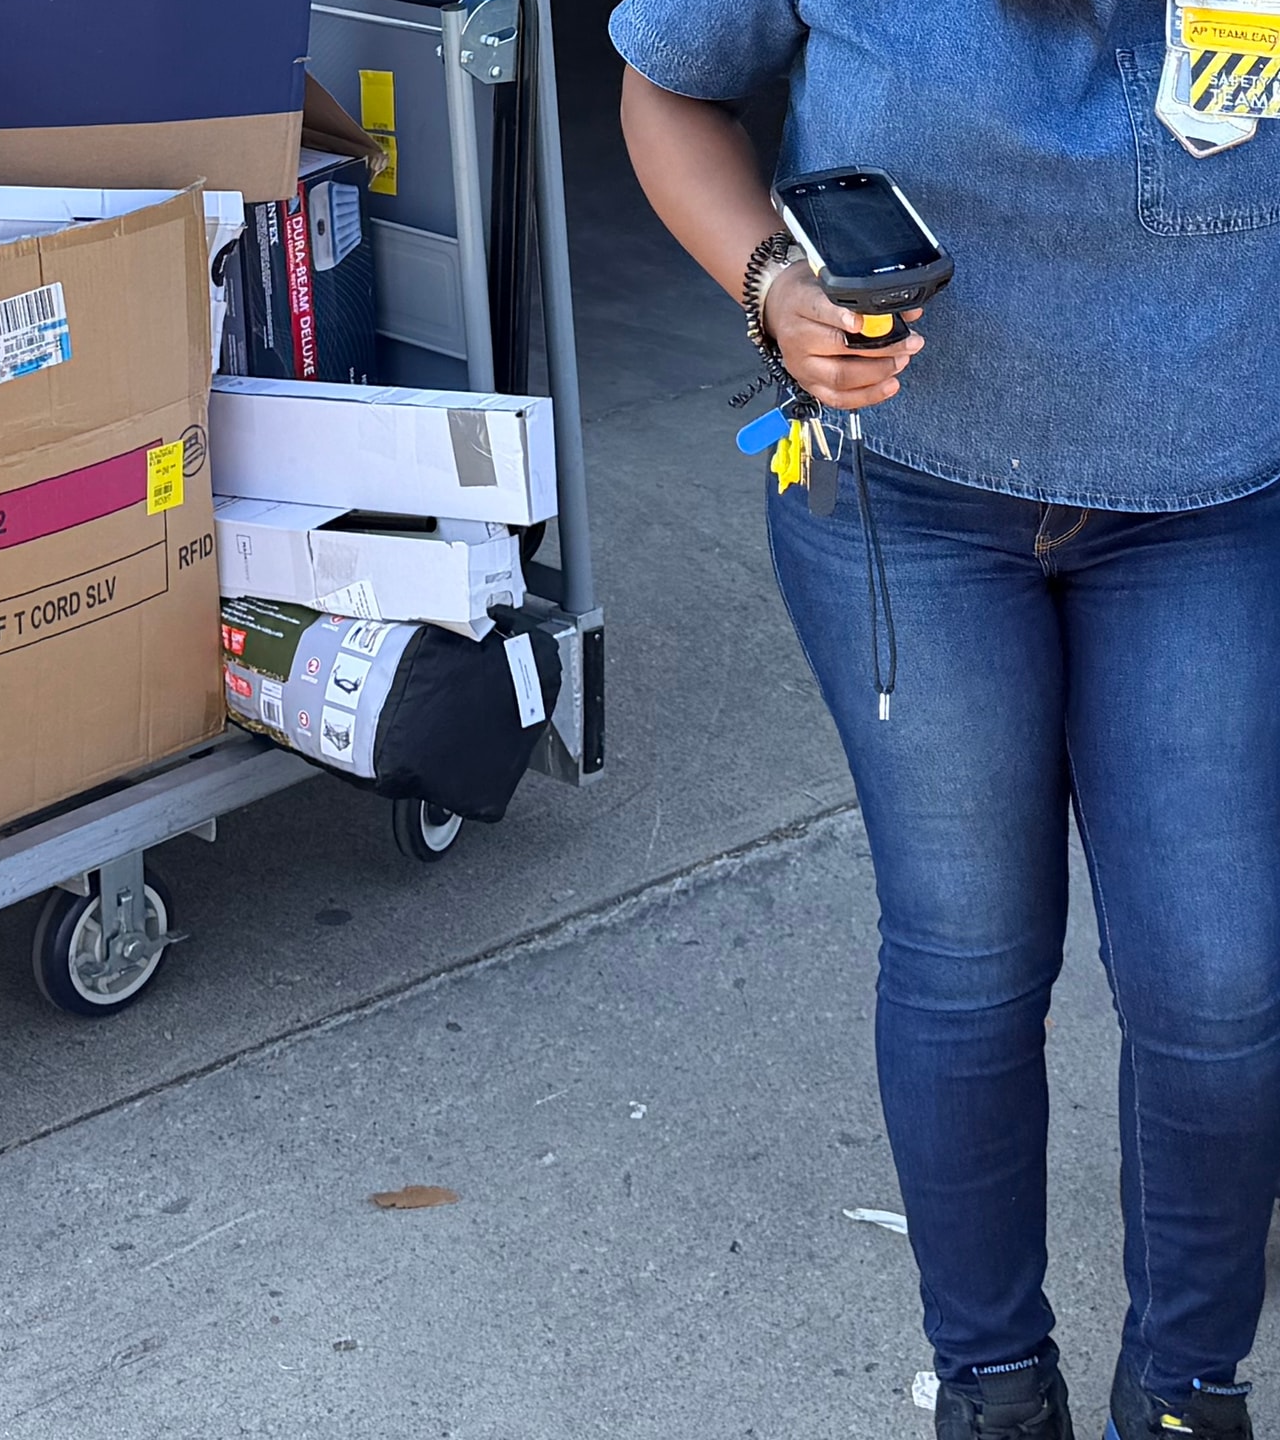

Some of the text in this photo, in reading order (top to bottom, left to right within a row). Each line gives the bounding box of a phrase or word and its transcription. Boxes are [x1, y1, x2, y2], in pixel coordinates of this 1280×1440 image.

[1209, 72, 1269, 88] SAFETY
[1209, 89, 1268, 109] TEAM
[293, 216, 315, 377] DURA-BEAM DELUXE
[178, 533, 214, 570] RFID
[14, 612, 26, 635] T
[30, 596, 81, 630] CORD
[86, 576, 117, 606] SLV
